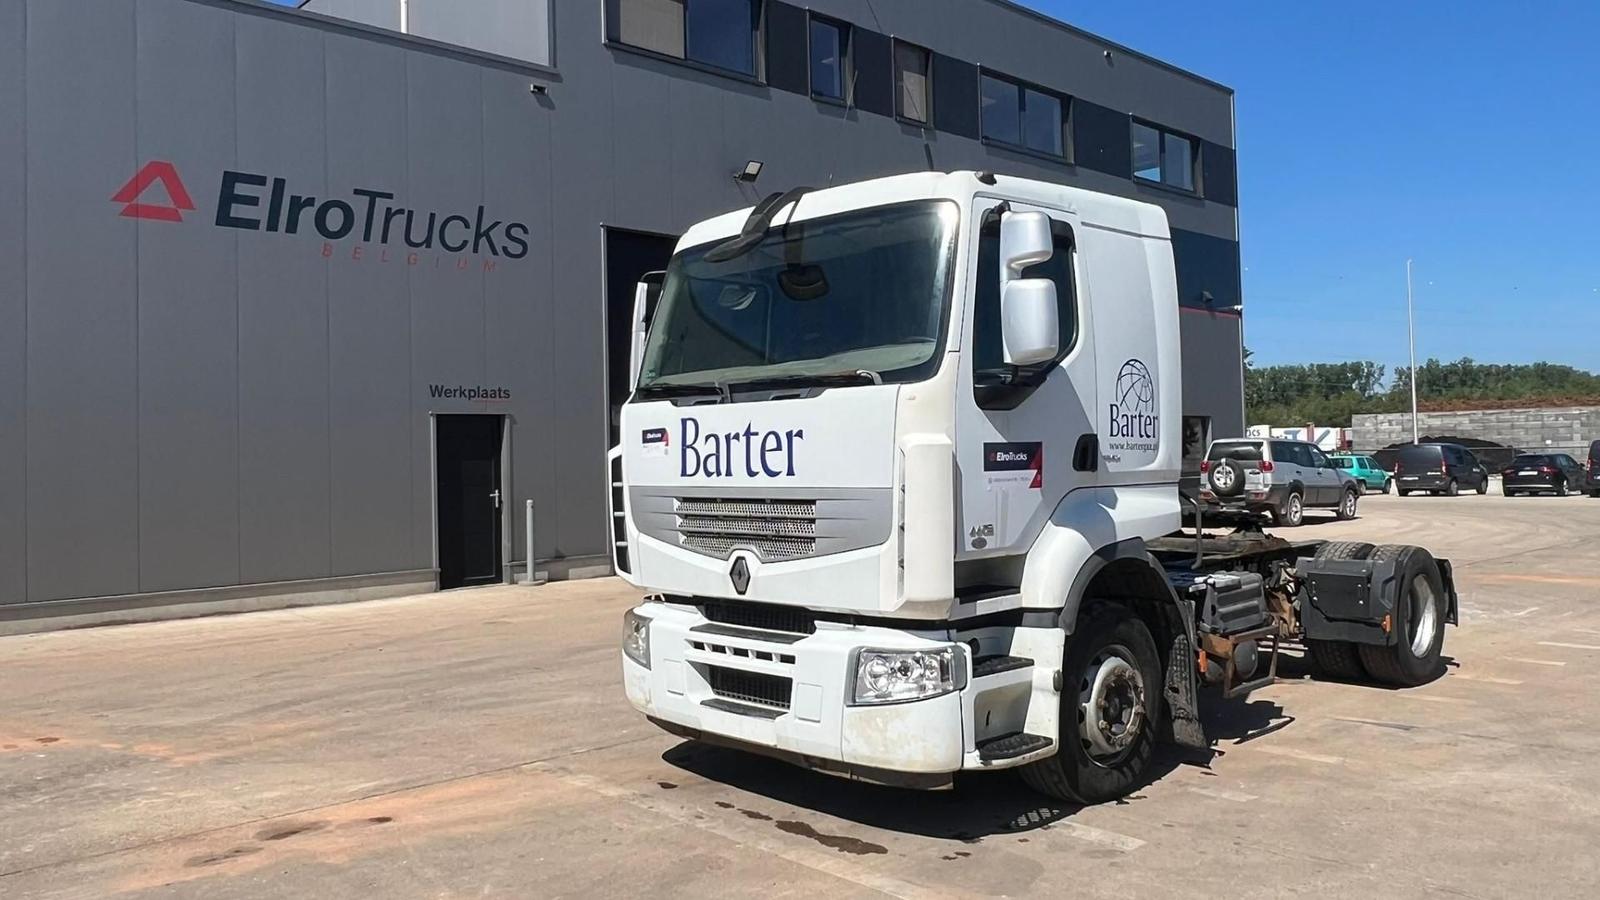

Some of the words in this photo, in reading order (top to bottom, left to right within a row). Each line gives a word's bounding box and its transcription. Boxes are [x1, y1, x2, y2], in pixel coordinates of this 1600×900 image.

[215, 170, 529, 259] ElroTrucks
[321, 242, 496, 272] BELGIUM
[429, 384, 510, 401] Werkplaats
[1109, 403, 1159, 438] Barter
[680, 417, 804, 478] Barter
[996, 451, 1028, 462] ElroTrucks
